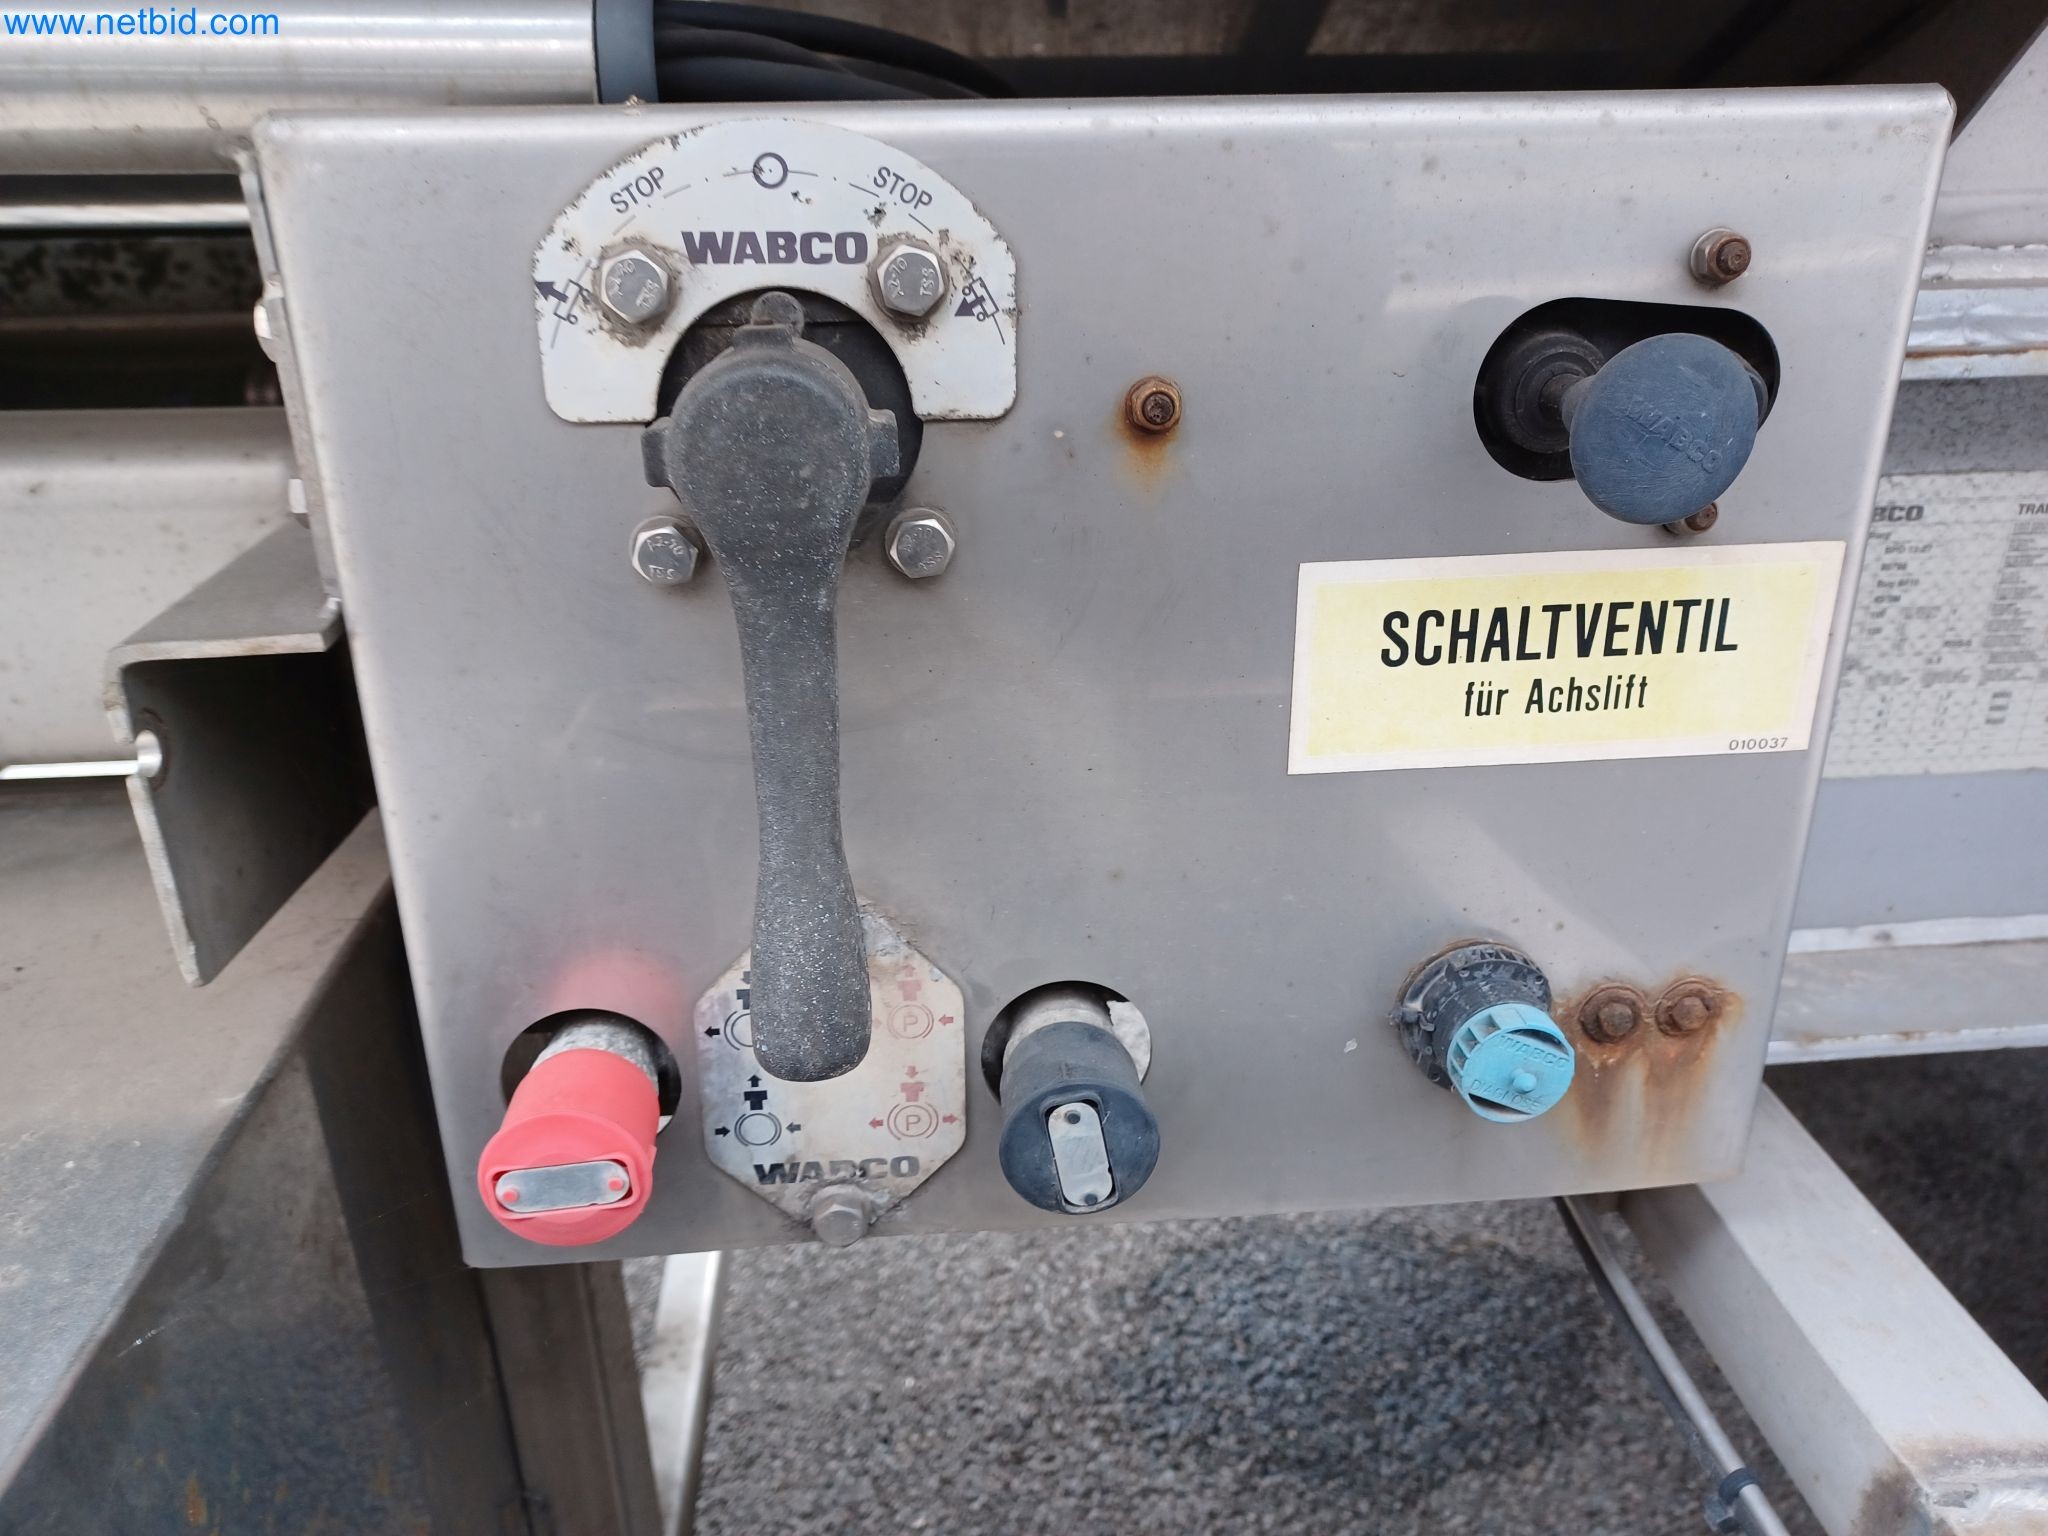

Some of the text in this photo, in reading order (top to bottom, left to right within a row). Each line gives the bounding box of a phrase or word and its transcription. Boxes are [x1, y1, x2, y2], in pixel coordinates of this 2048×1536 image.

[610, 166, 665, 213] STOP
[873, 166, 933, 210] STOP
[681, 231, 868, 265] WABCO
[1871, 504, 1925, 522] BCO
[1381, 598, 1738, 667] SCHALTVENTIL
[1464, 674, 1648, 717] für Achslift
[1729, 736, 1788, 751] 010037
[905, 1114, 921, 1131] P
